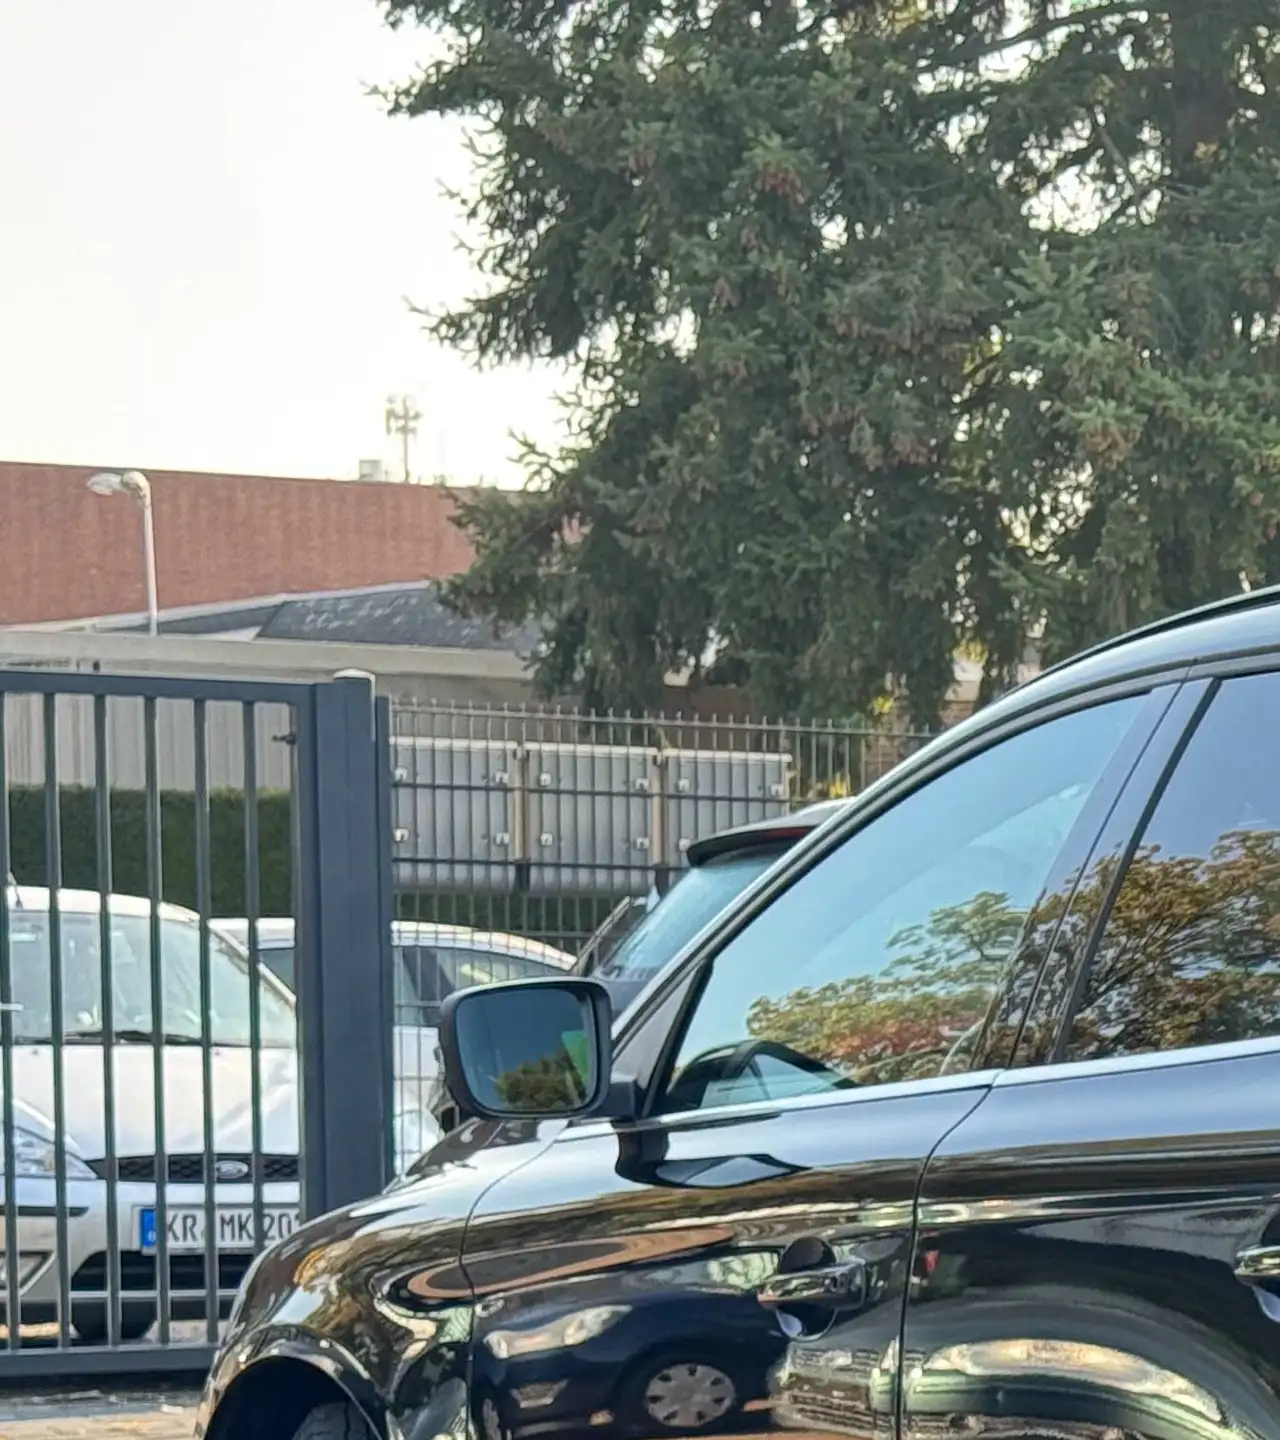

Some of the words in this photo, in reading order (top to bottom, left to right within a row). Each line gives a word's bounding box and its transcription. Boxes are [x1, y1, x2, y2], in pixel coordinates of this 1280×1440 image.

[166, 1212, 199, 1243] KR
[219, 1212, 254, 1242] MK
[261, 1211, 300, 1241] 20
